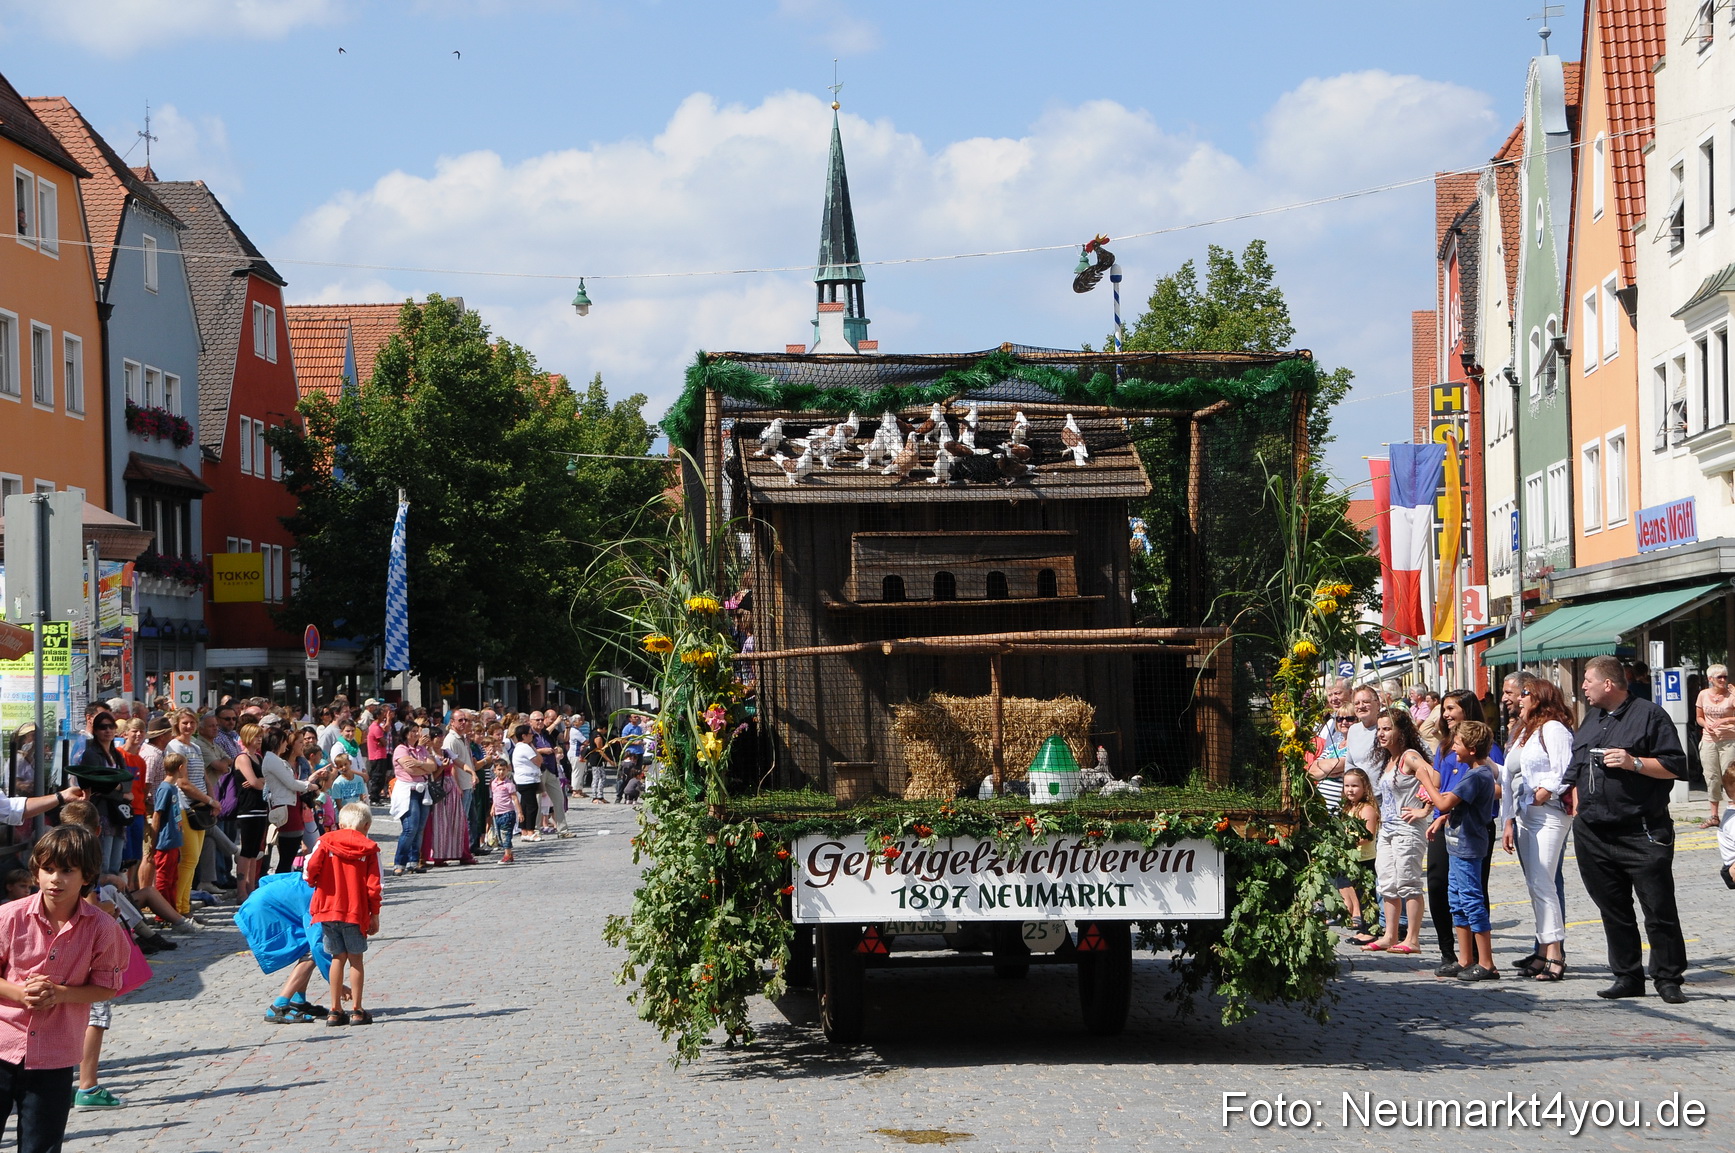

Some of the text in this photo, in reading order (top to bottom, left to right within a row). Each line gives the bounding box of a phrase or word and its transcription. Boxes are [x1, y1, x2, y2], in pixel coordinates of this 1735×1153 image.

[1638, 501, 1695, 547] Jeans Wölfl
[1668, 675, 1678, 689] P
[891, 882, 1134, 910] 1897 NEUMARKT
[1023, 922, 1048, 940] 25
